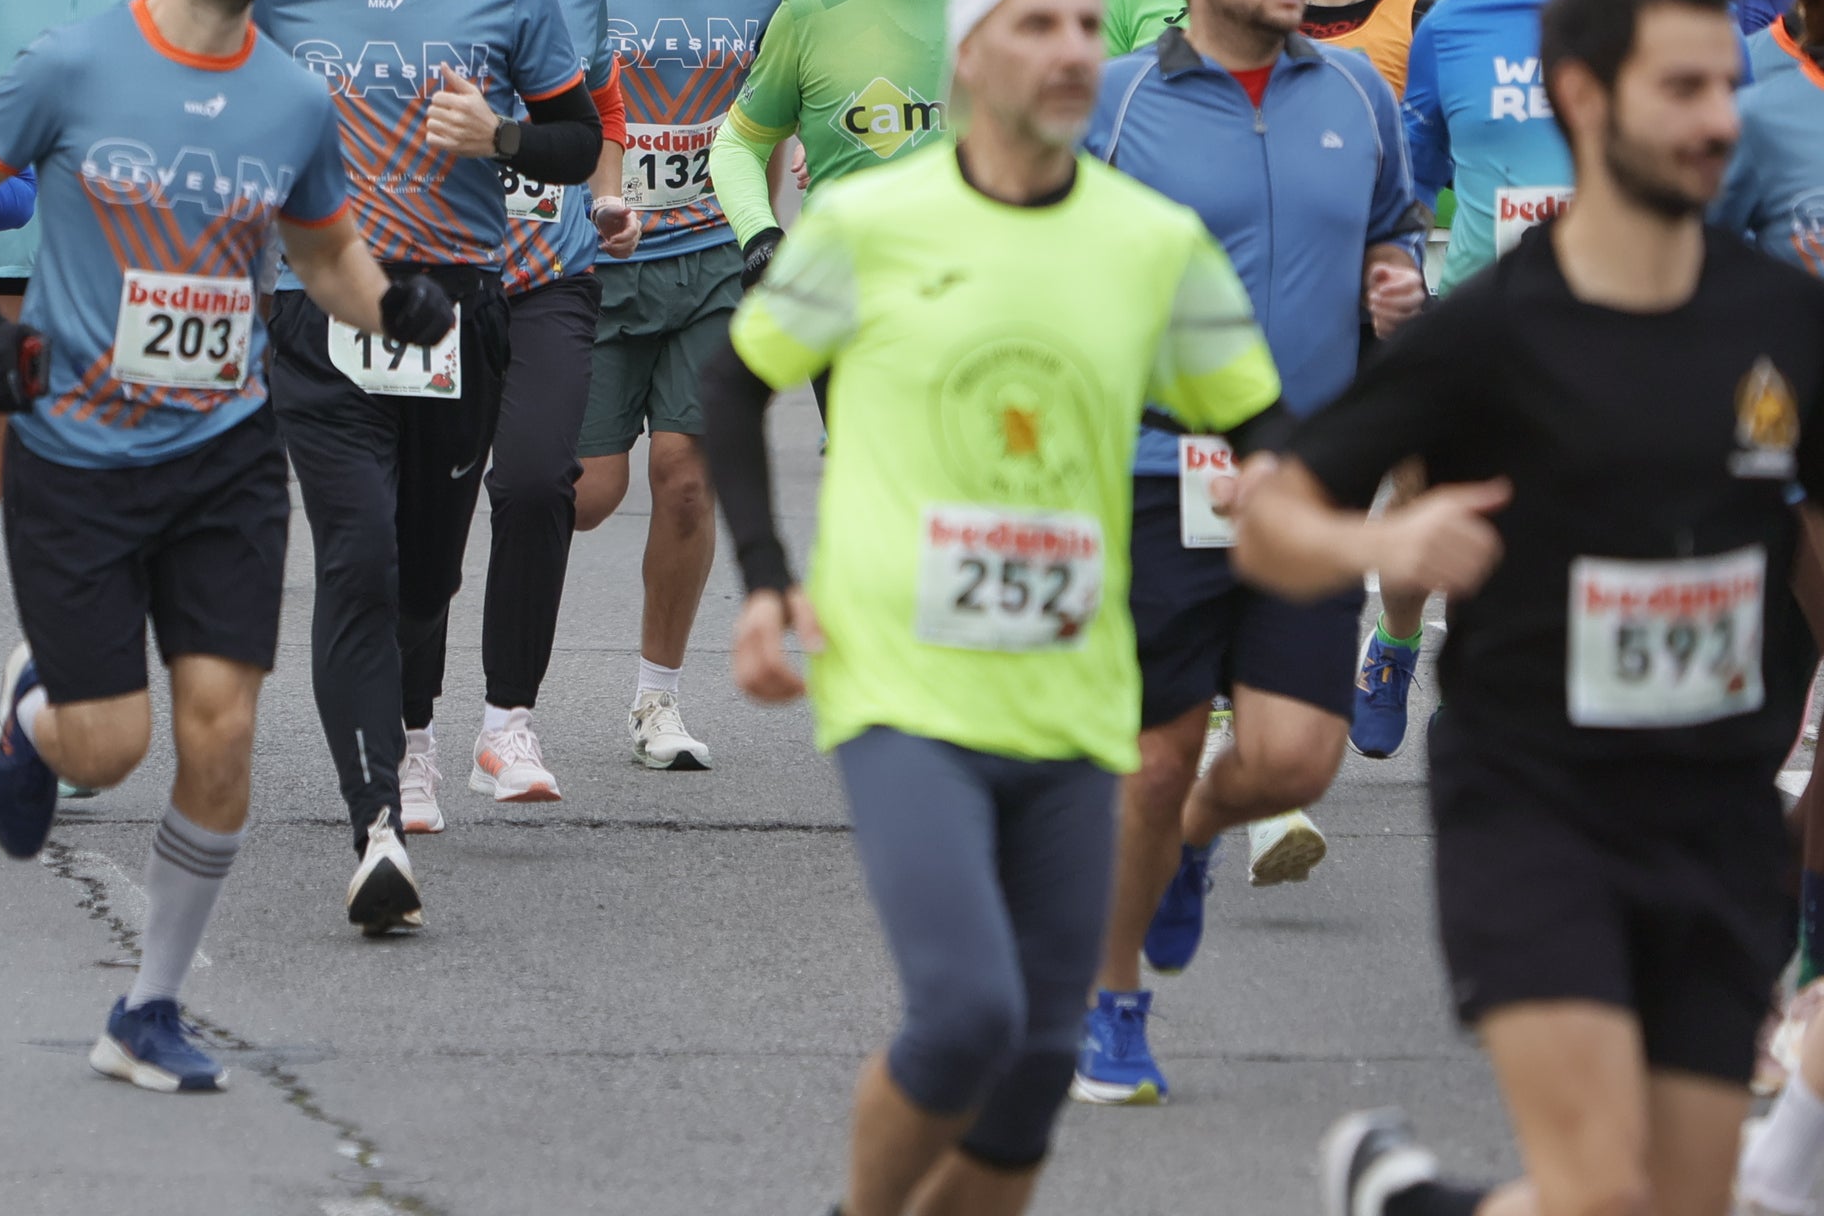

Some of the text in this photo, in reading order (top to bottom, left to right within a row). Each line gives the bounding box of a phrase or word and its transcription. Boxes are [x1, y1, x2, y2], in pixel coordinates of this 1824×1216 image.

[308, 62, 489, 80] ILVESTRE
[845, 102, 947, 134] cam
[639, 148, 711, 191] 132
[129, 280, 250, 314] bedunia
[143, 313, 232, 360] 203
[954, 558, 1072, 615] 252
